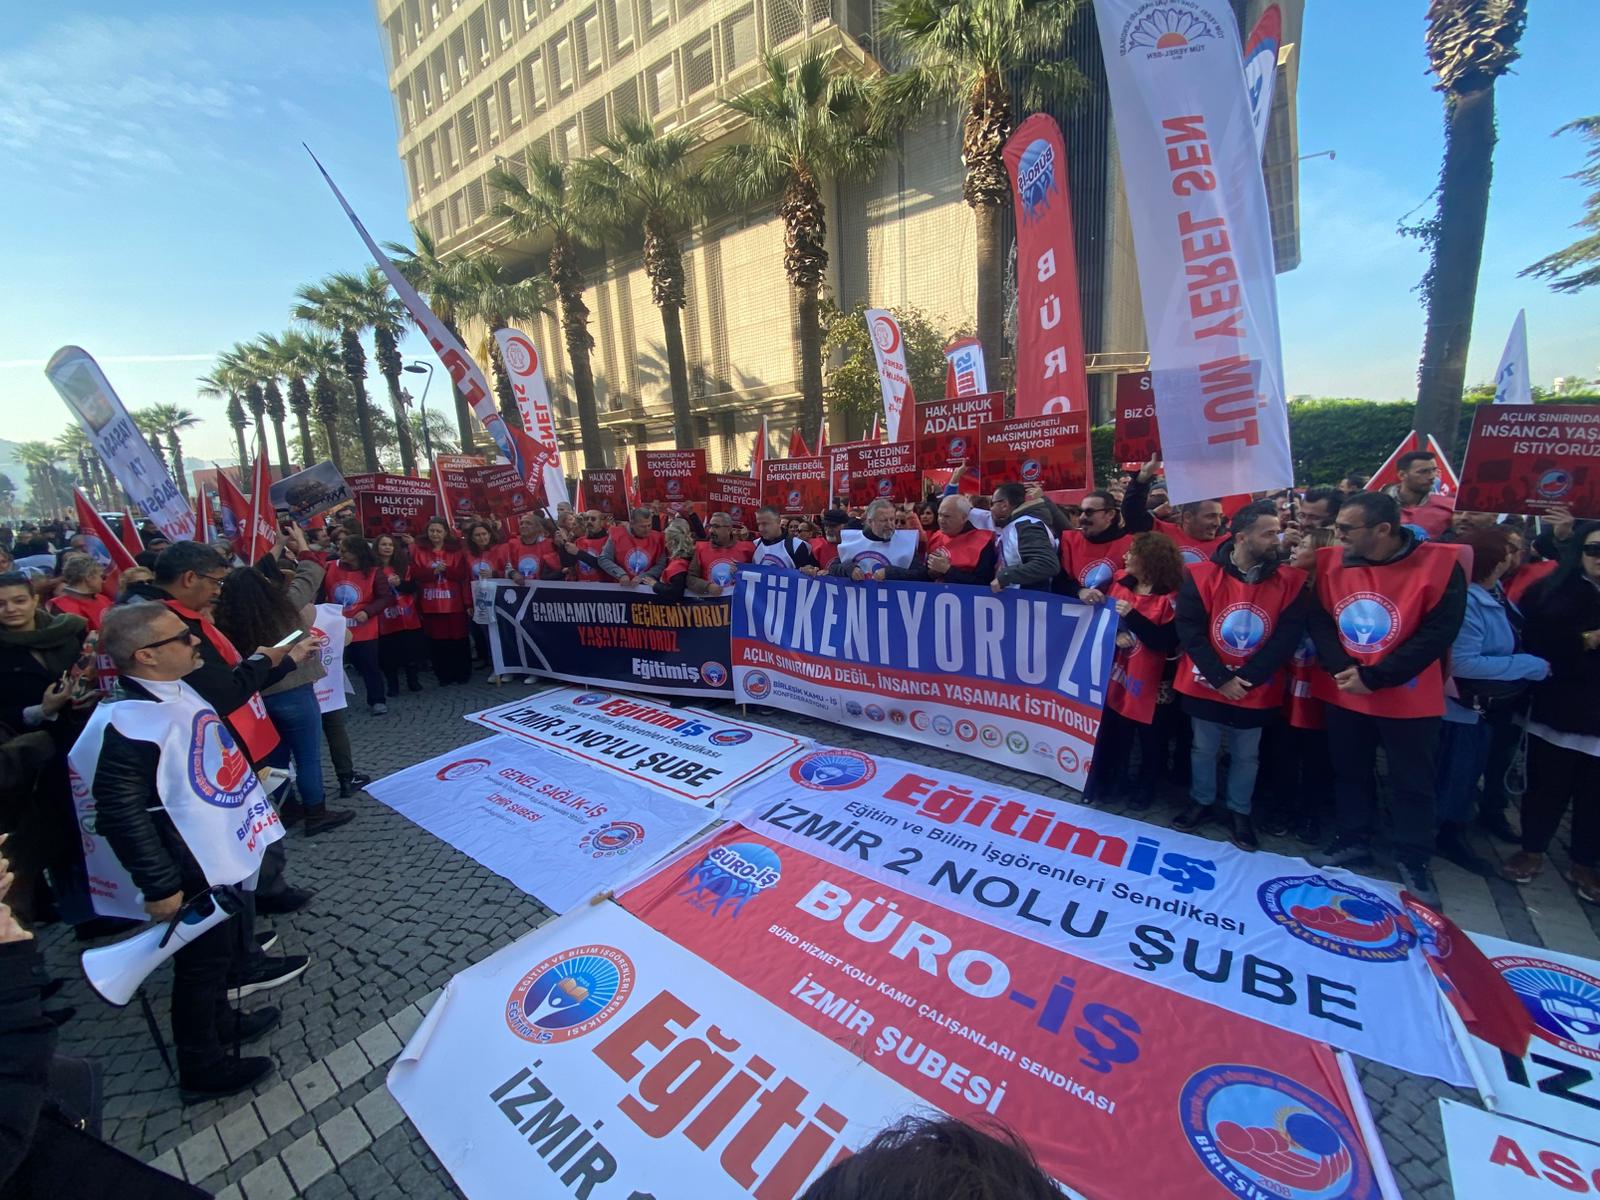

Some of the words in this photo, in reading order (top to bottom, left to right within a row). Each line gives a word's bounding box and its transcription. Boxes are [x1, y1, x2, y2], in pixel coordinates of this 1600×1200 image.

[952, 398, 992, 414] HUKUK
[1500, 412, 1536, 424] AÇLIK
[1481, 424, 1560, 438] İNSANCA
[858, 449, 873, 460] SİZ
[873, 445, 910, 458] YEDİNİZ
[1008, 438, 1055, 452] YAŞIYOR!
[648, 459, 696, 470] EKMEĞİMLE
[768, 462, 802, 474] ÇETELERE
[802, 460, 824, 470] DEĞİL
[868, 457, 902, 469] HESABI
[588, 473, 604, 482] HALK
[654, 469, 692, 477] OYNAMA
[766, 471, 801, 482] EMEKÇİYE
[801, 468, 826, 481] BÜTÇE
[374, 496, 402, 504] HALK
[403, 496, 424, 506] İÇİN
[382, 505, 417, 517] BÜTÇE!
[532, 601, 628, 625] BARINAMIYORUZ
[631, 601, 731, 628] GEÇİNEMİYORUZ
[576, 626, 680, 652] YAŞAYAMIYORUZ
[741, 570, 1111, 705] TÜKENİYORUZ!
[743, 646, 775, 664] AÇLIK
[775, 655, 832, 680] SINIRINDA
[834, 667, 876, 689] DEĞİL,
[877, 674, 941, 698] İNSANCA
[943, 684, 1021, 712] YAŞAMAK
[498, 705, 566, 733] İZMİR
[551, 724, 582, 738] 3
[628, 752, 723, 788] ŞUBE
[498, 767, 542, 790] GENEL
[536, 784, 608, 820] SAĞLIK-İŞ
[710, 846, 780, 888] BÜRO-İŞ
[844, 800, 898, 827] Eğitim
[902, 819, 923, 834] ve
[926, 826, 978, 852] Bilim
[981, 840, 1104, 893] İşgörenleri
[1111, 882, 1245, 936] Sendikası
[758, 798, 884, 861] İZMİR
[883, 847, 924, 875] 2
[928, 860, 1109, 938] NOLU
[1128, 923, 1364, 1032] ŞUBE
[552, 954, 566, 964] VE
[569, 946, 598, 957] BİLİM
[795, 879, 1142, 1074] BÜRO-İŞ
[566, 994, 625, 1037] SENDİKASI
[768, 924, 800, 946] BÜRO
[799, 940, 844, 968] HİZMET
[842, 963, 877, 988] KOLU
[876, 982, 918, 1008] KAMU
[917, 1005, 1016, 1062] ÇALIŞANLARI
[1018, 1056, 1116, 1114] SENDİKASI
[790, 973, 875, 1037] İZMİR
[874, 1026, 1008, 1116] ŞUBESİ
[1257, 1175, 1292, 1198] 2008
